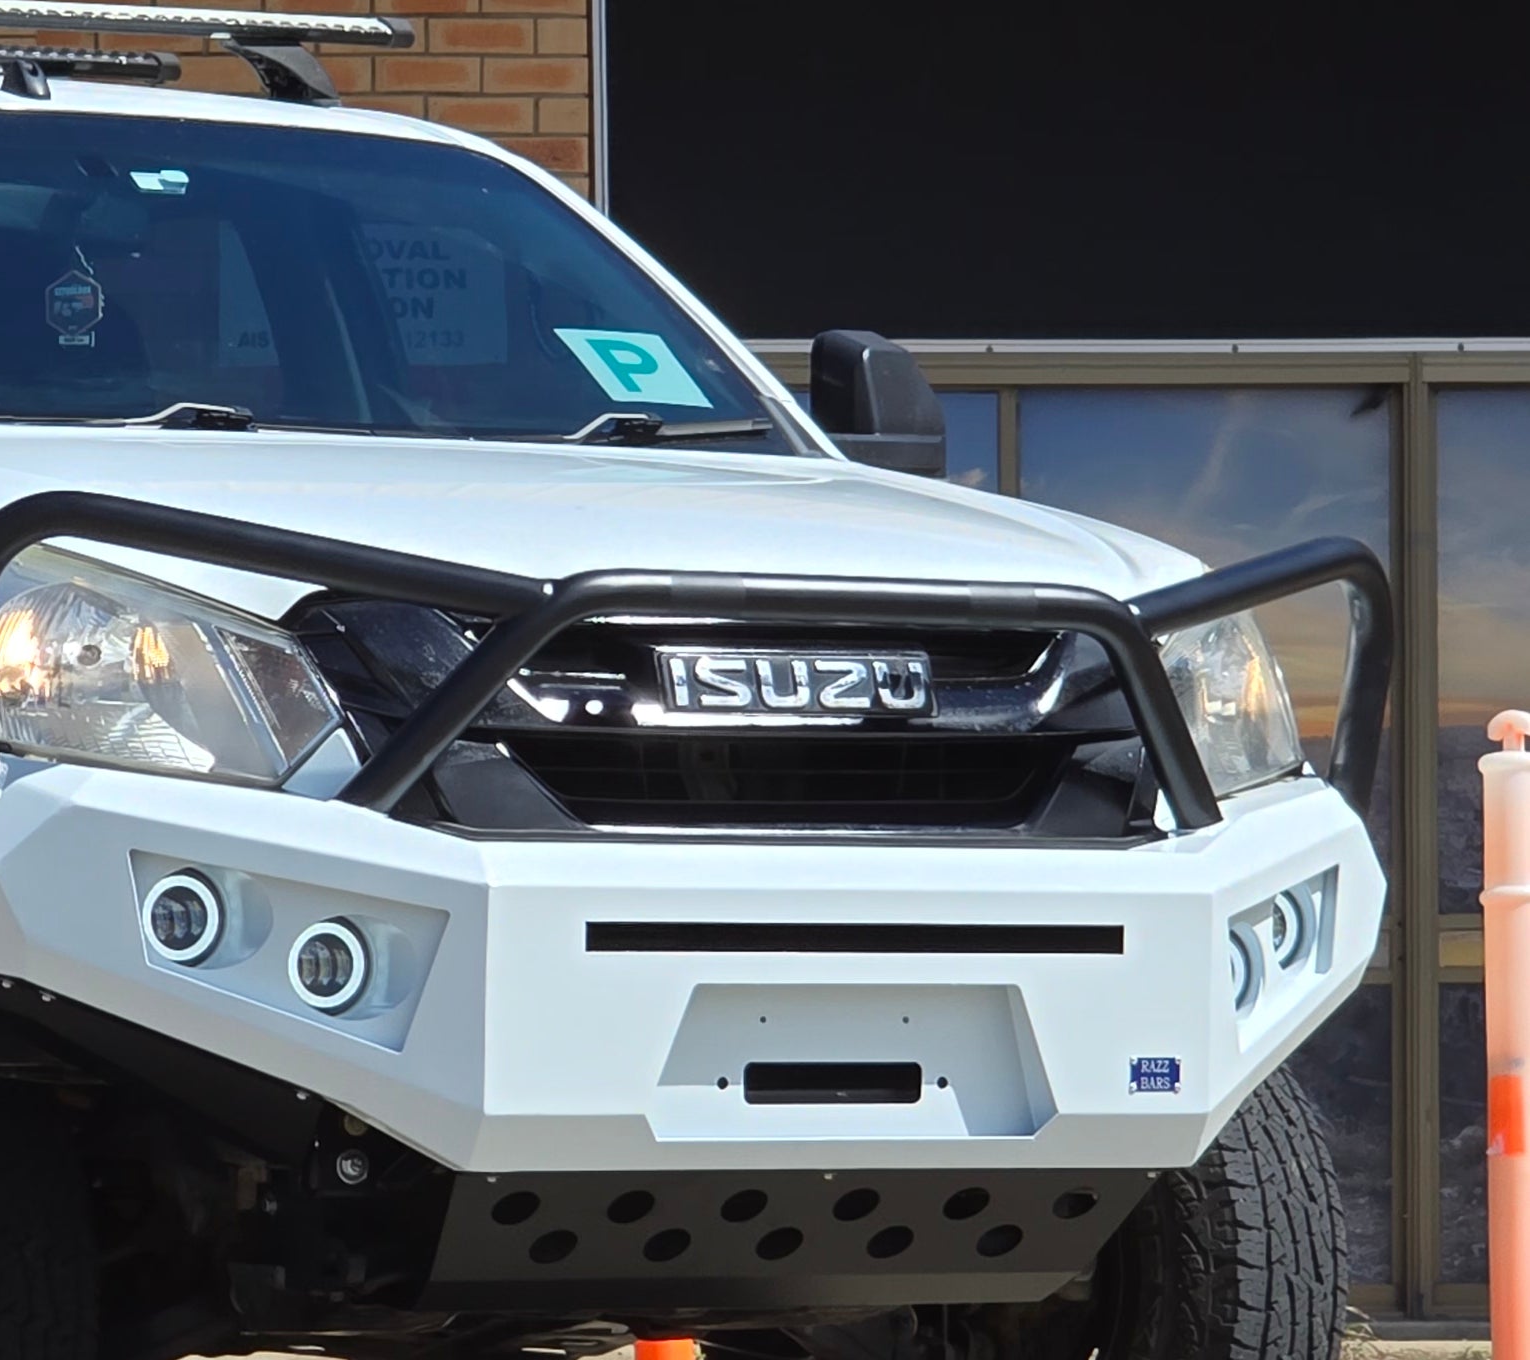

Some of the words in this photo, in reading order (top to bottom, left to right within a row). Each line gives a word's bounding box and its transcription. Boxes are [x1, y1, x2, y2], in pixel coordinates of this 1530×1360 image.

[584, 338, 658, 392] P
[668, 655, 927, 709] ISUZU
[1140, 1060, 1170, 1073] RAZZ
[1140, 1077, 1171, 1089] BARS
